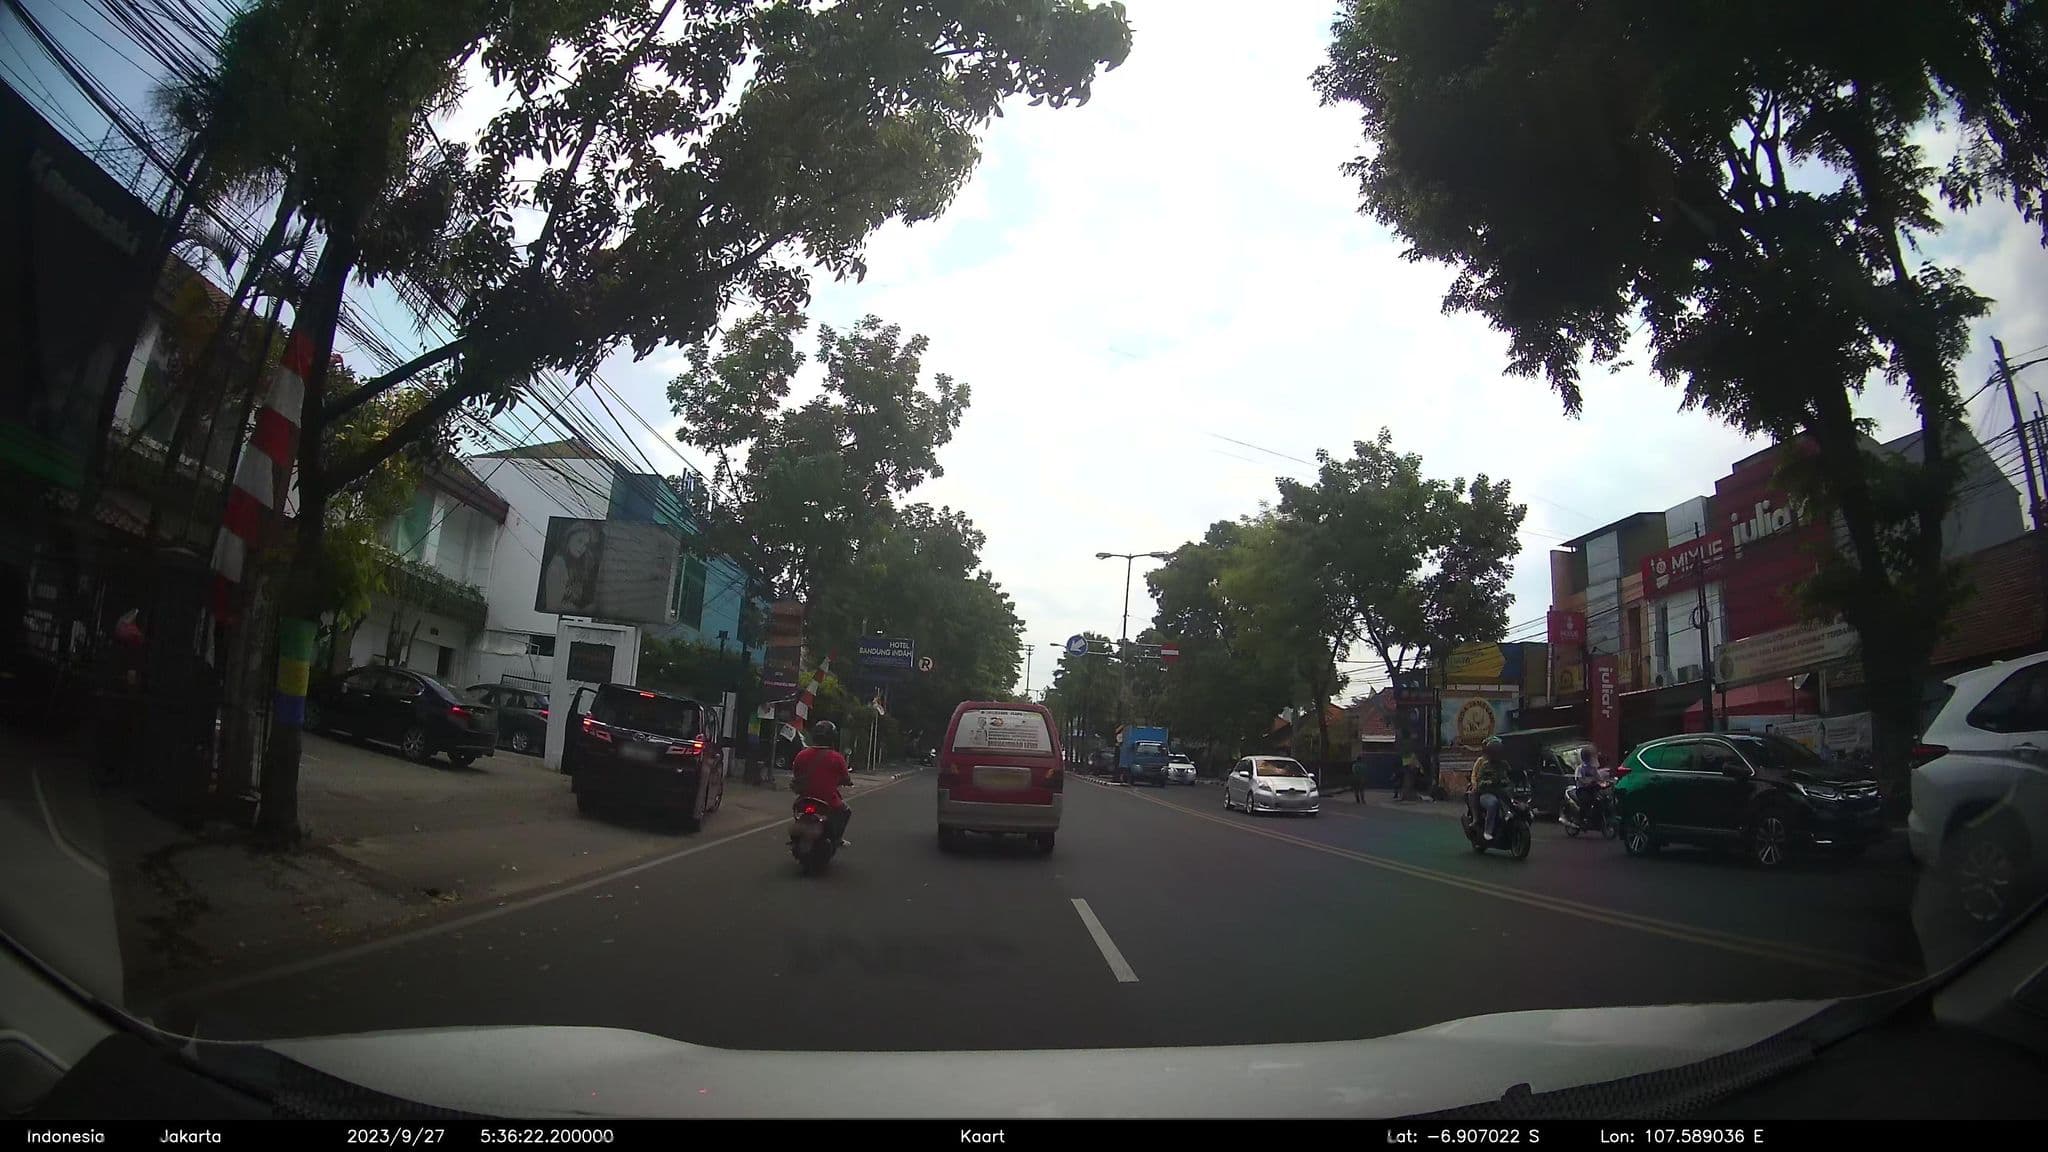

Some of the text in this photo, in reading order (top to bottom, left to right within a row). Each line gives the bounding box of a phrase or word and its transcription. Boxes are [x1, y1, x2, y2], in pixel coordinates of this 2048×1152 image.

[889, 641, 910, 649] HOTEL
[859, 647, 912, 657] BANDUNG INDAH
